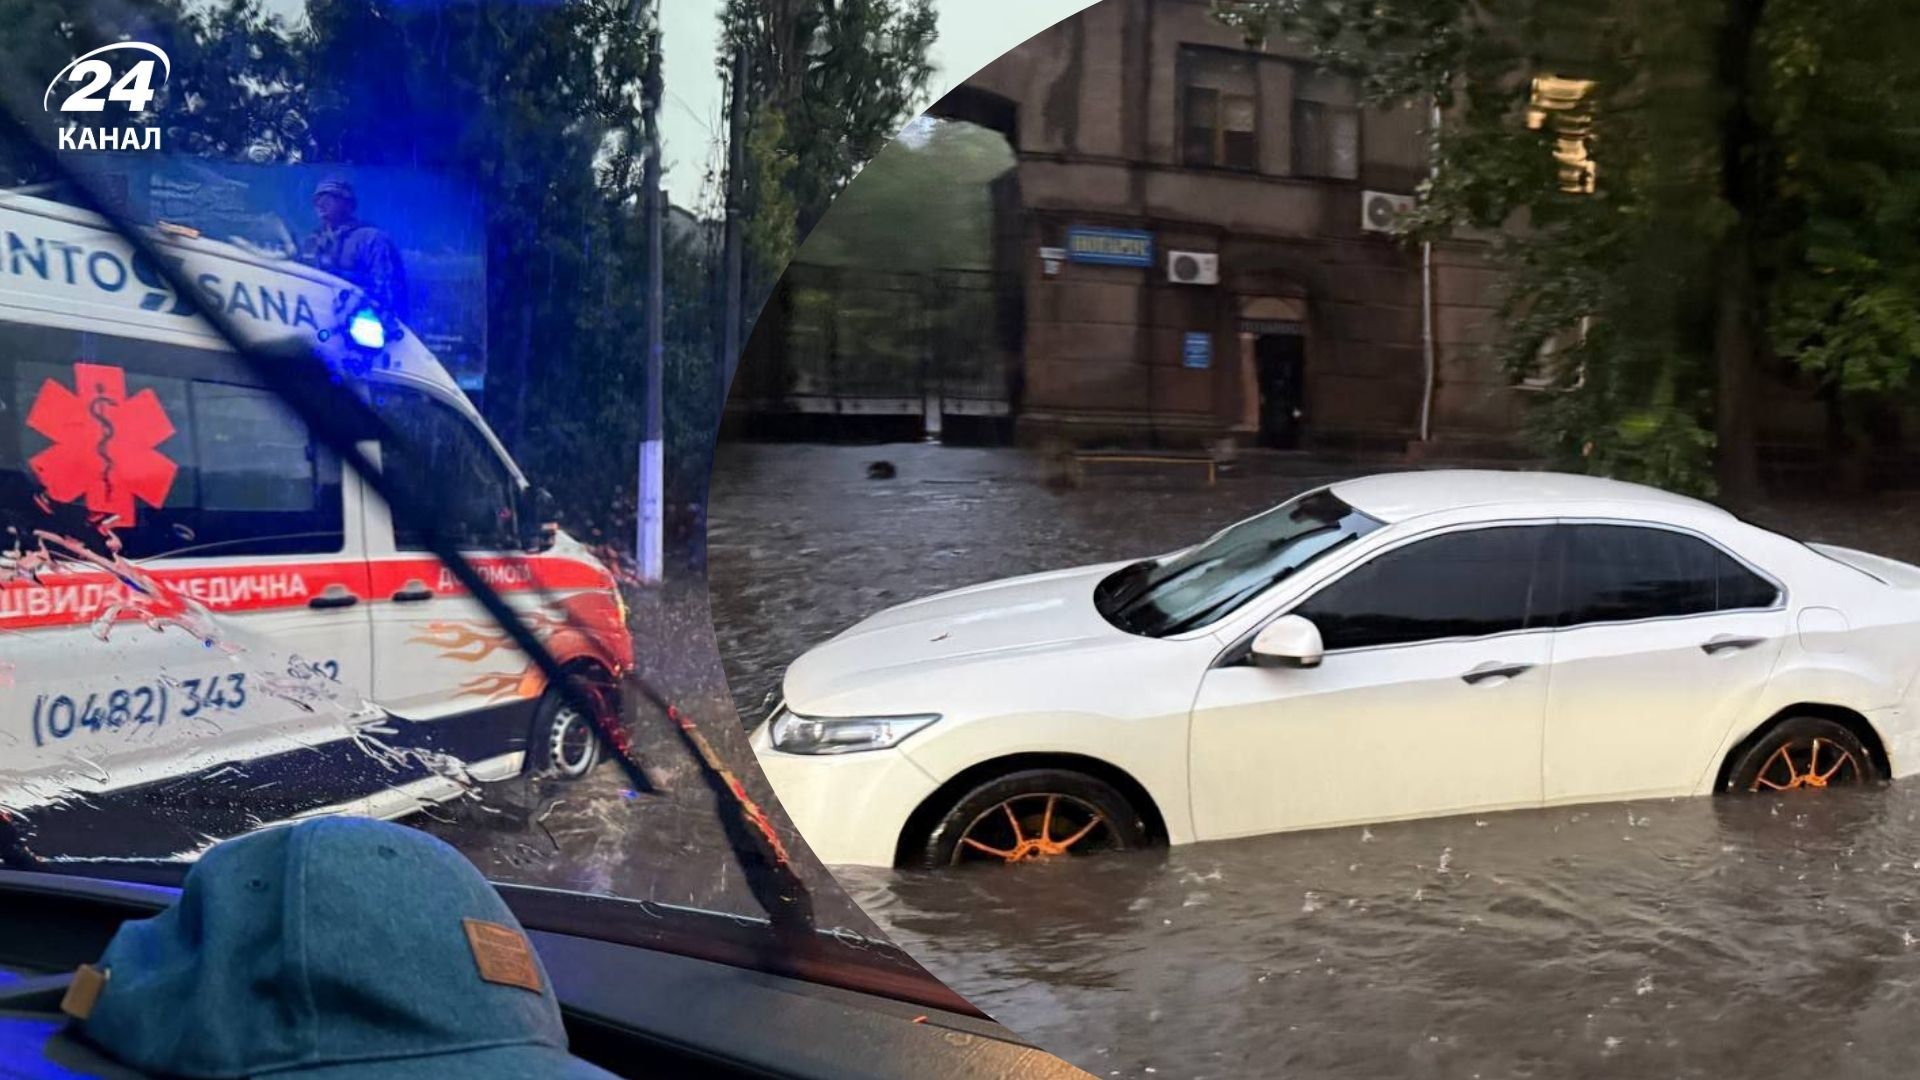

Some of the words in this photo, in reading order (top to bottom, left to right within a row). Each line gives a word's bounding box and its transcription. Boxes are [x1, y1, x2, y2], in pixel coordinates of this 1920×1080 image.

[197, 273, 319, 331] SANA
[0, 582, 146, 618] ШВИДК
[437, 563, 532, 591] ДОМОГА
[32, 685, 168, 748] (0482)
[180, 672, 246, 718] 343
